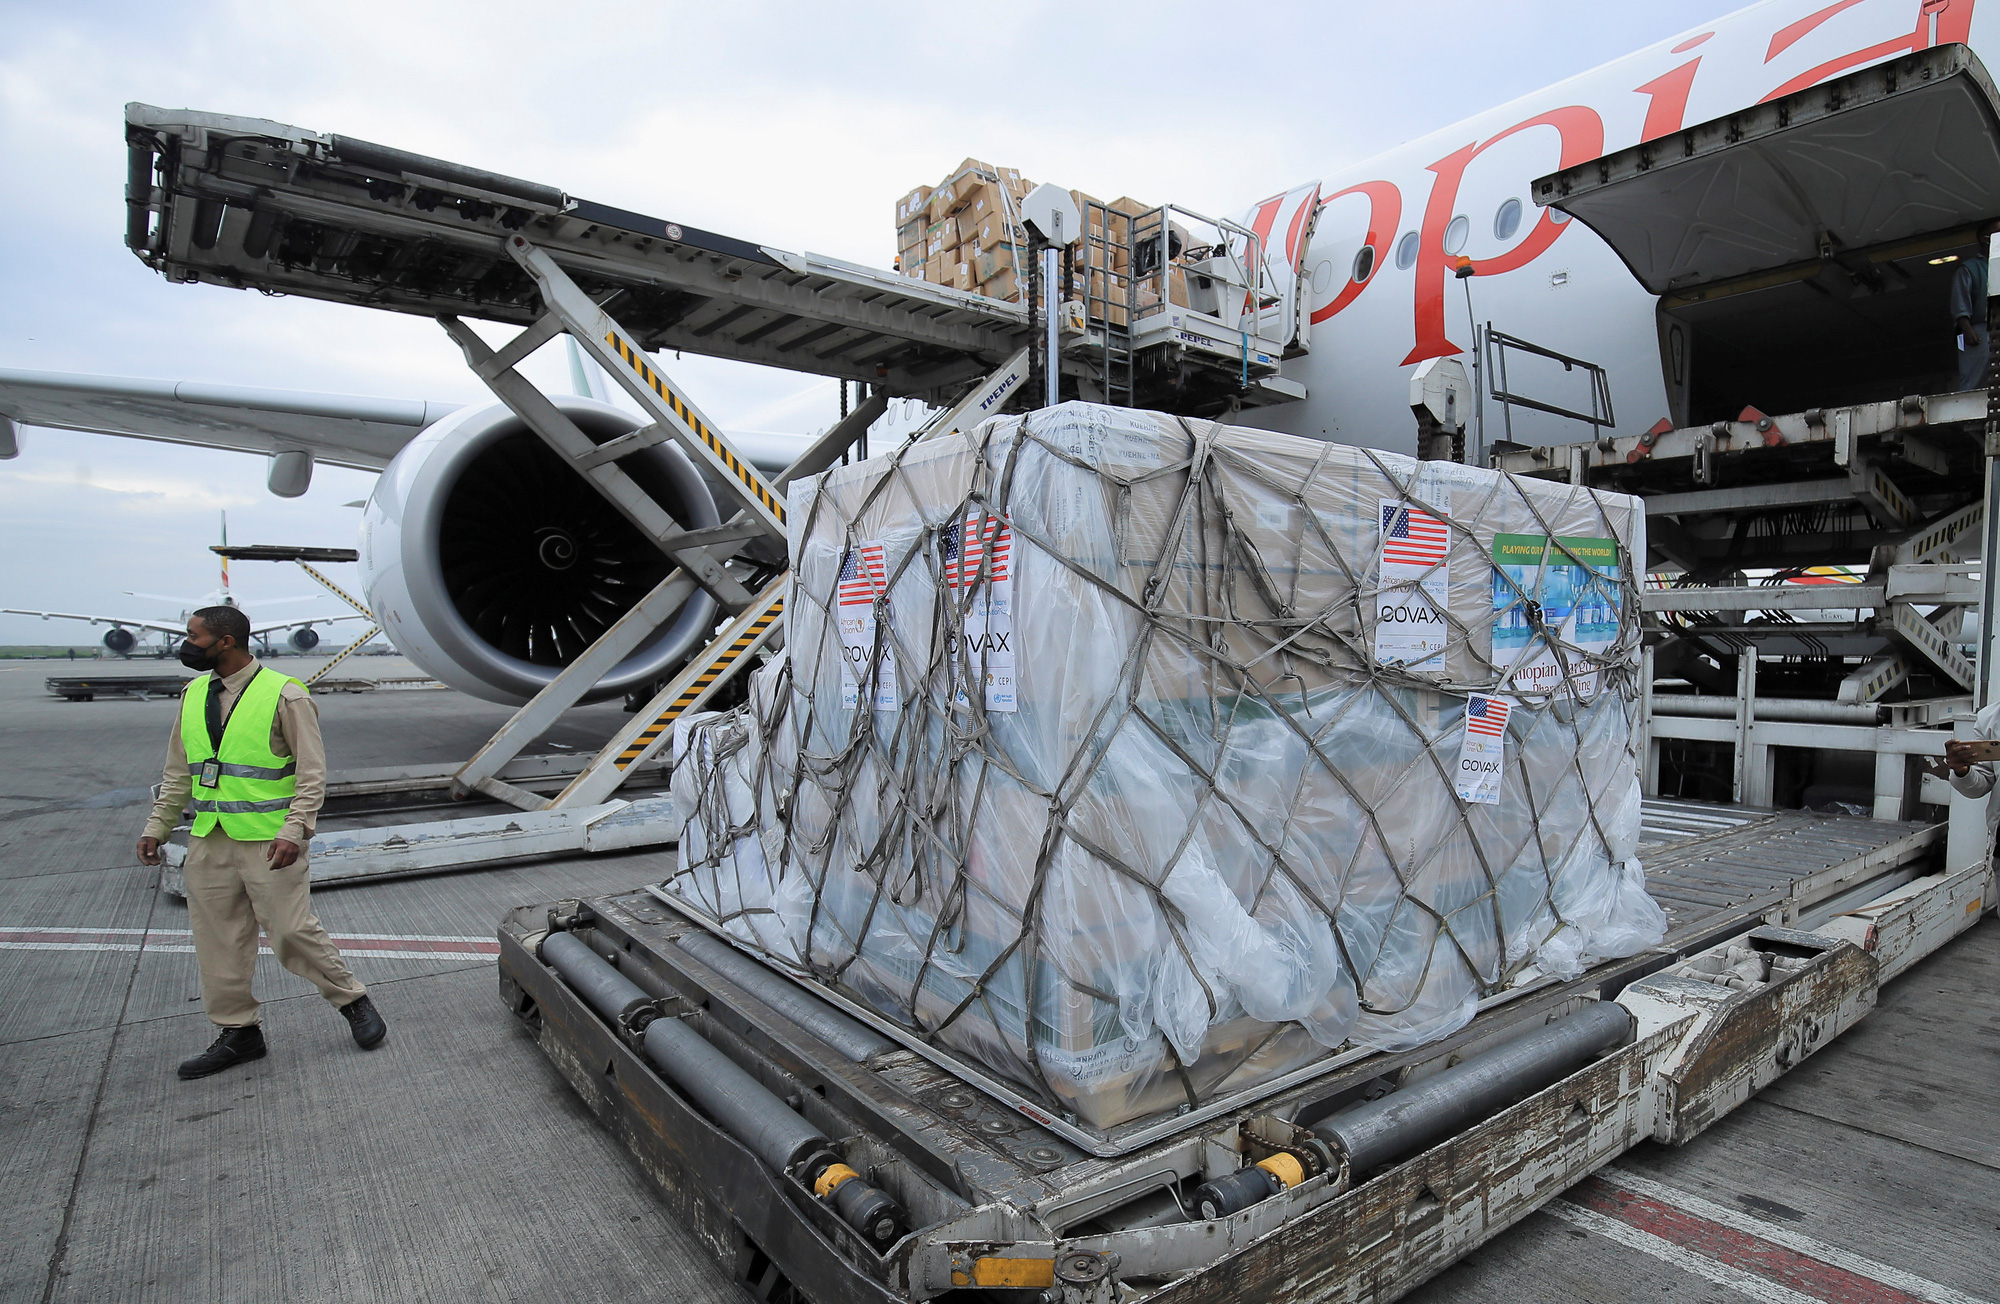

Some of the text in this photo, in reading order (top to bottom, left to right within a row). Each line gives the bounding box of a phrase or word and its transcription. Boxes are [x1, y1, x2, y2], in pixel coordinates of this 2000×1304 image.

[1175, 331, 1214, 347] REPEL
[979, 372, 1020, 410] TREPEL
[1502, 545, 1530, 555] PLAYING
[1539, 546, 1555, 555] PT
[1554, 547, 1562, 556] IN
[1562, 547, 1582, 556] ING
[1581, 547, 1592, 556] THE
[1591, 548, 1612, 557] WORLD!
[1381, 605, 1443, 625] COVAX
[843, 645, 891, 662] COVX
[1503, 660, 1592, 683] hiopian argo
[998, 677, 1012, 686] CEPI
[1532, 683, 1568, 695] Phara
[1461, 759, 1500, 774] COVAX
